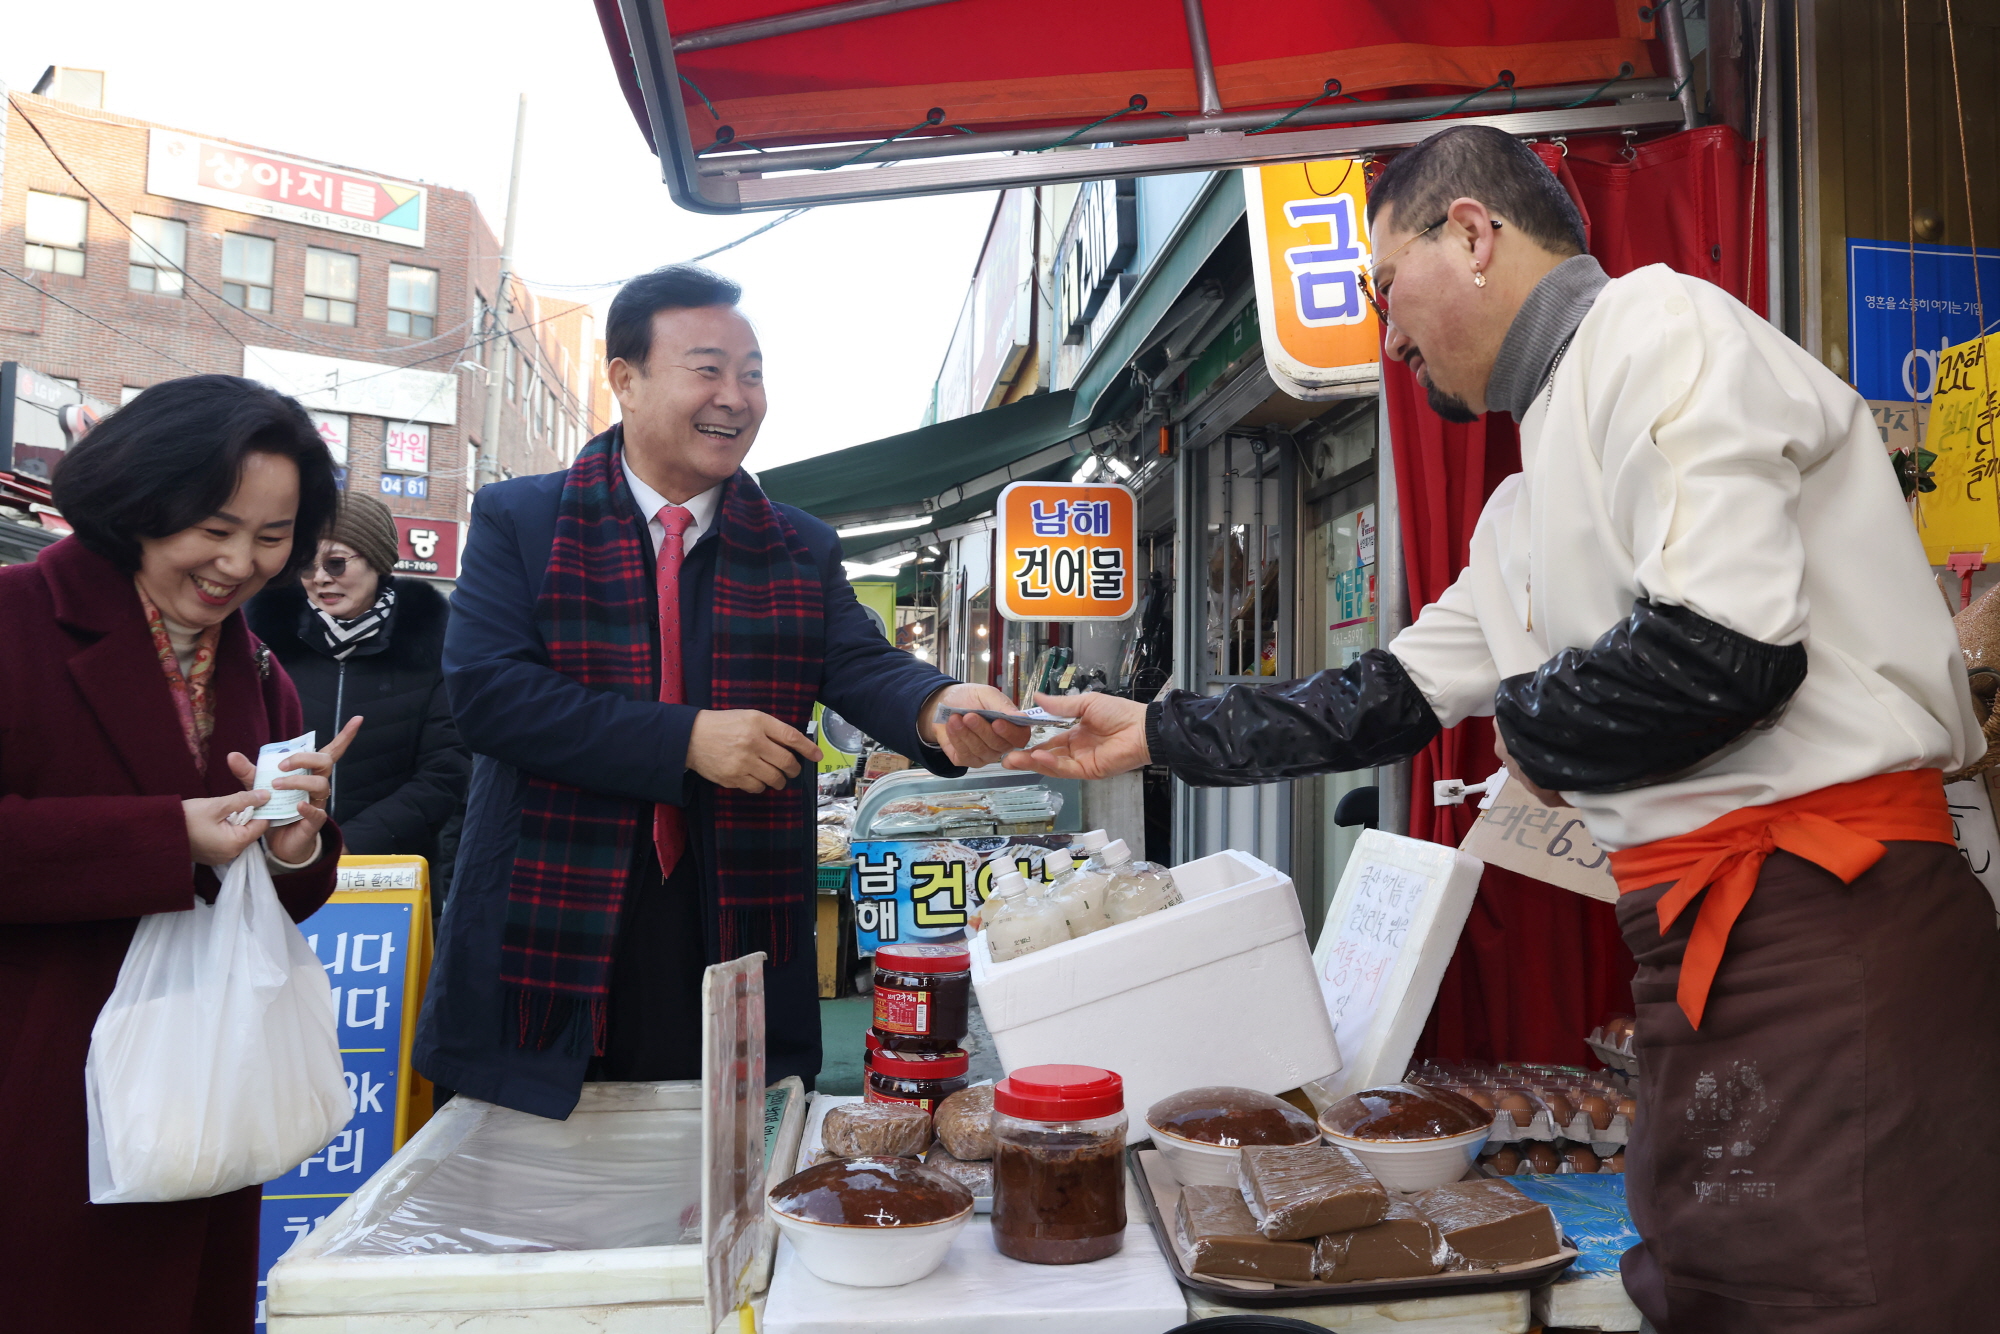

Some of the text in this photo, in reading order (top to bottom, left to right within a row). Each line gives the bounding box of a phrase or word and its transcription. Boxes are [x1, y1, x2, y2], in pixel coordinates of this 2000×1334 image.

[300, 211, 381, 235] 461-3281
[1286, 196, 1370, 324] 금
[1865, 295, 1896, 310] 영혼을
[1898, 298, 1929, 312] 소중히
[1930, 300, 1961, 315] 여기는
[34, 381, 47, 400] LG
[389, 429, 426, 463] 학원
[381, 477, 425, 496] 04 61
[1030, 499, 1111, 536] 남해
[409, 528, 439, 559] 당
[1013, 546, 1126, 600] 건어물
[1484, 804, 1560, 850] 대란
